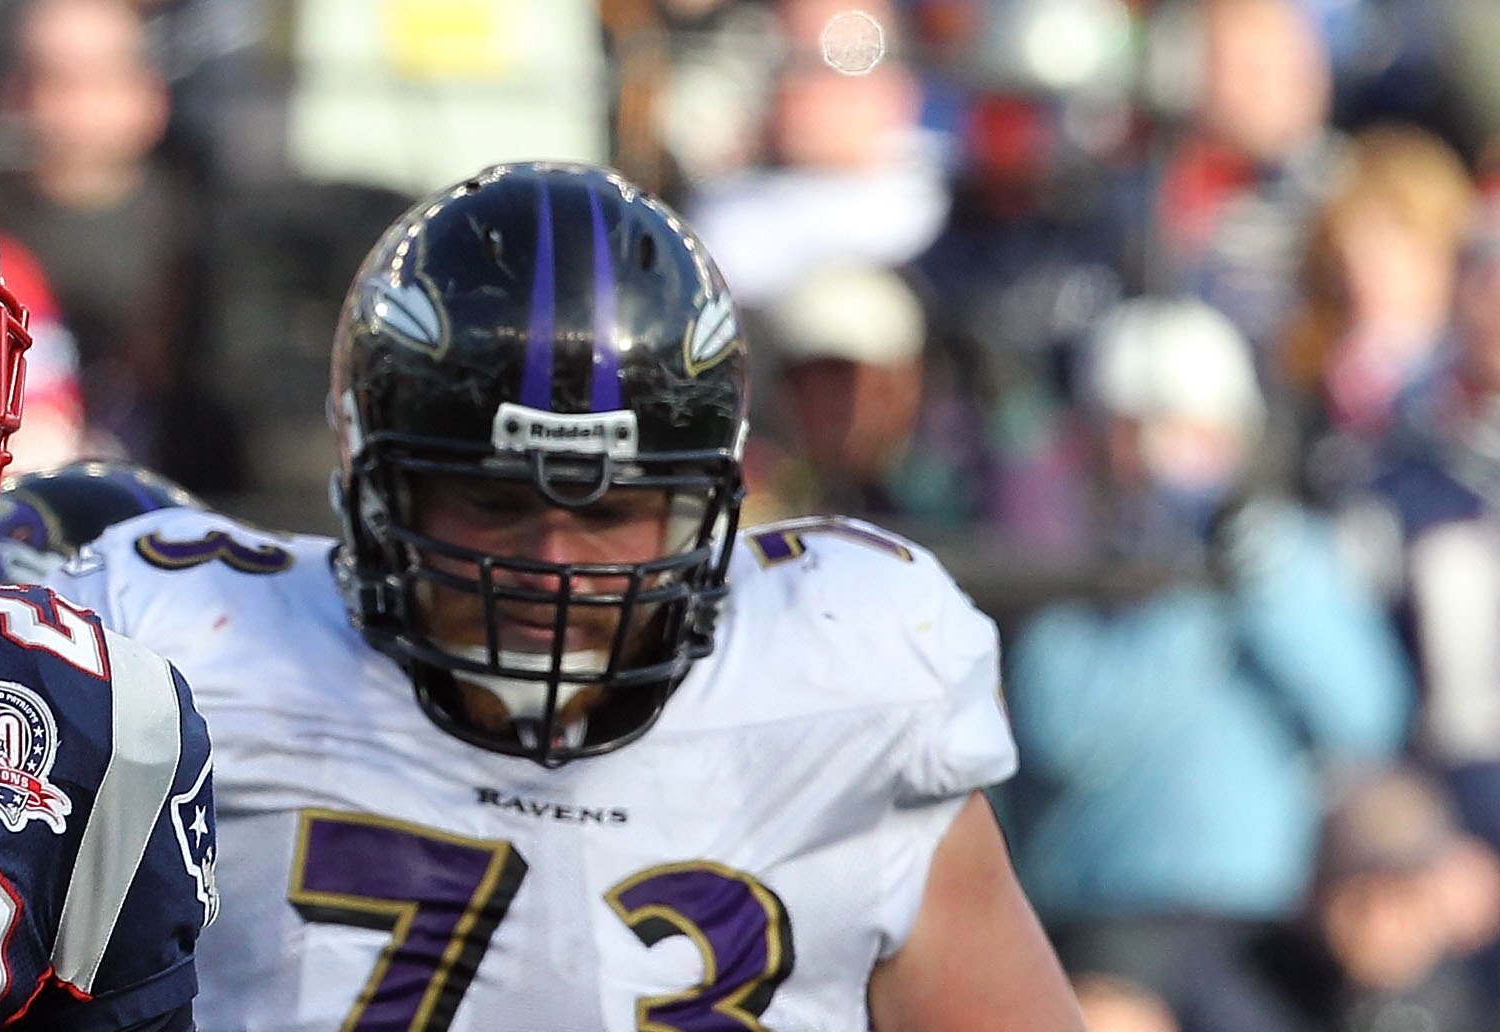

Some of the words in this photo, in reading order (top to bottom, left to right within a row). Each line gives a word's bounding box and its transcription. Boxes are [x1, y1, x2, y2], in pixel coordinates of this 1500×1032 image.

[530, 423, 606, 438] Riddell
[5, 693, 40, 723] PATRIOTS
[475, 787, 628, 823] RAVENS
